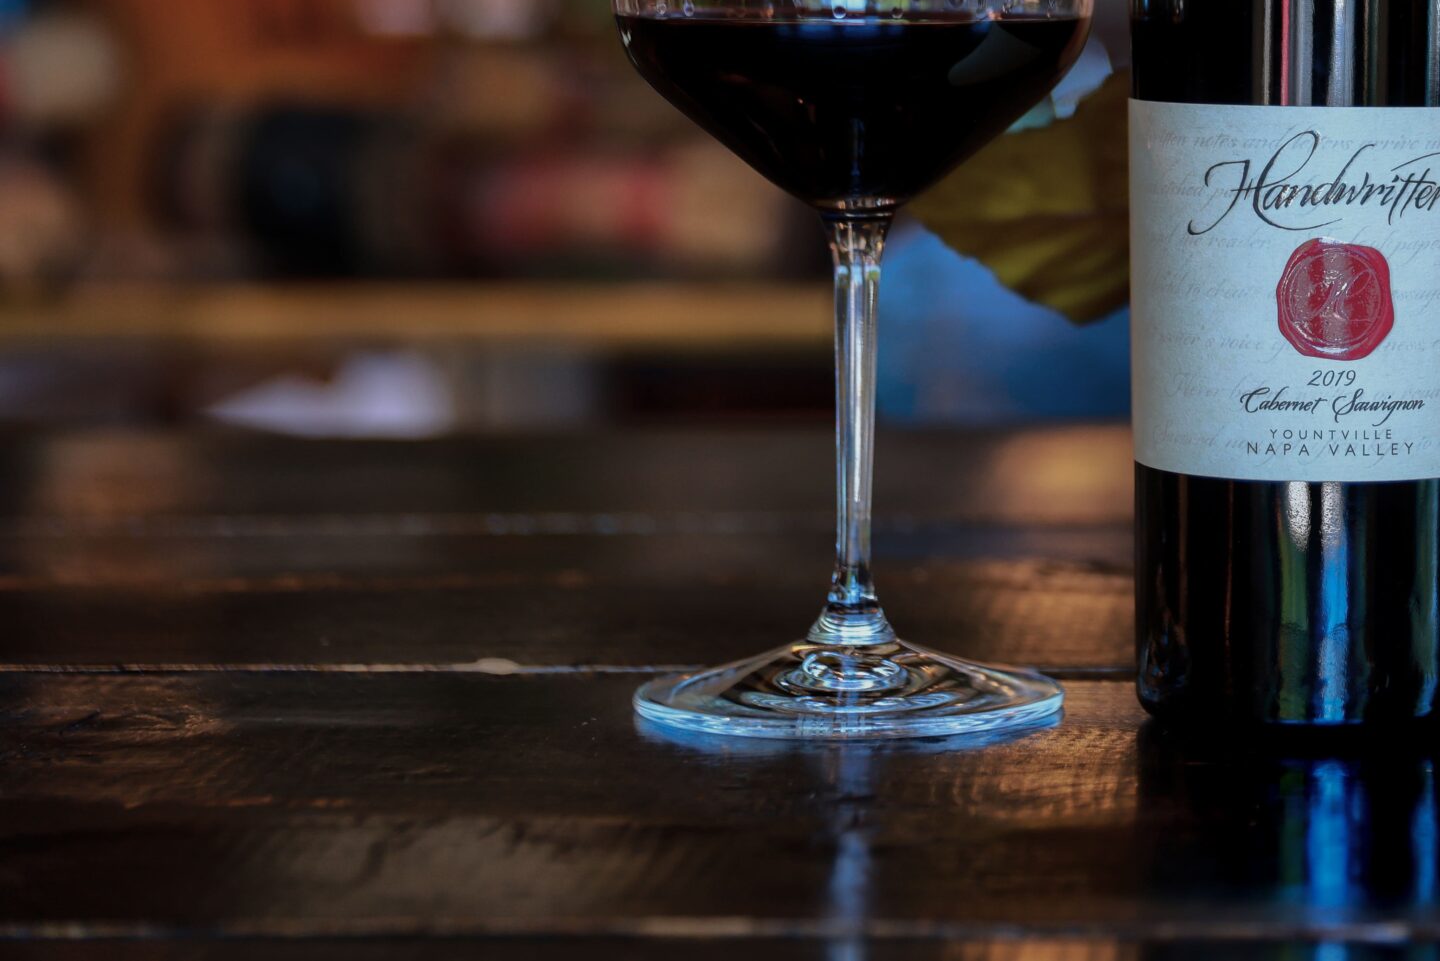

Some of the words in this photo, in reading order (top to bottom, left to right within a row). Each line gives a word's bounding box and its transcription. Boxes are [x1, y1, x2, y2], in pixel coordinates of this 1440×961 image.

[1306, 369, 1357, 387] 2019
[1239, 386, 1328, 414] Cabernet
[1331, 388, 1425, 427] Sauvignon
[1270, 428, 1393, 440] YOUNTVILLE
[1247, 441, 1310, 456] NAPA
[1328, 441, 1415, 457] VALLEY
